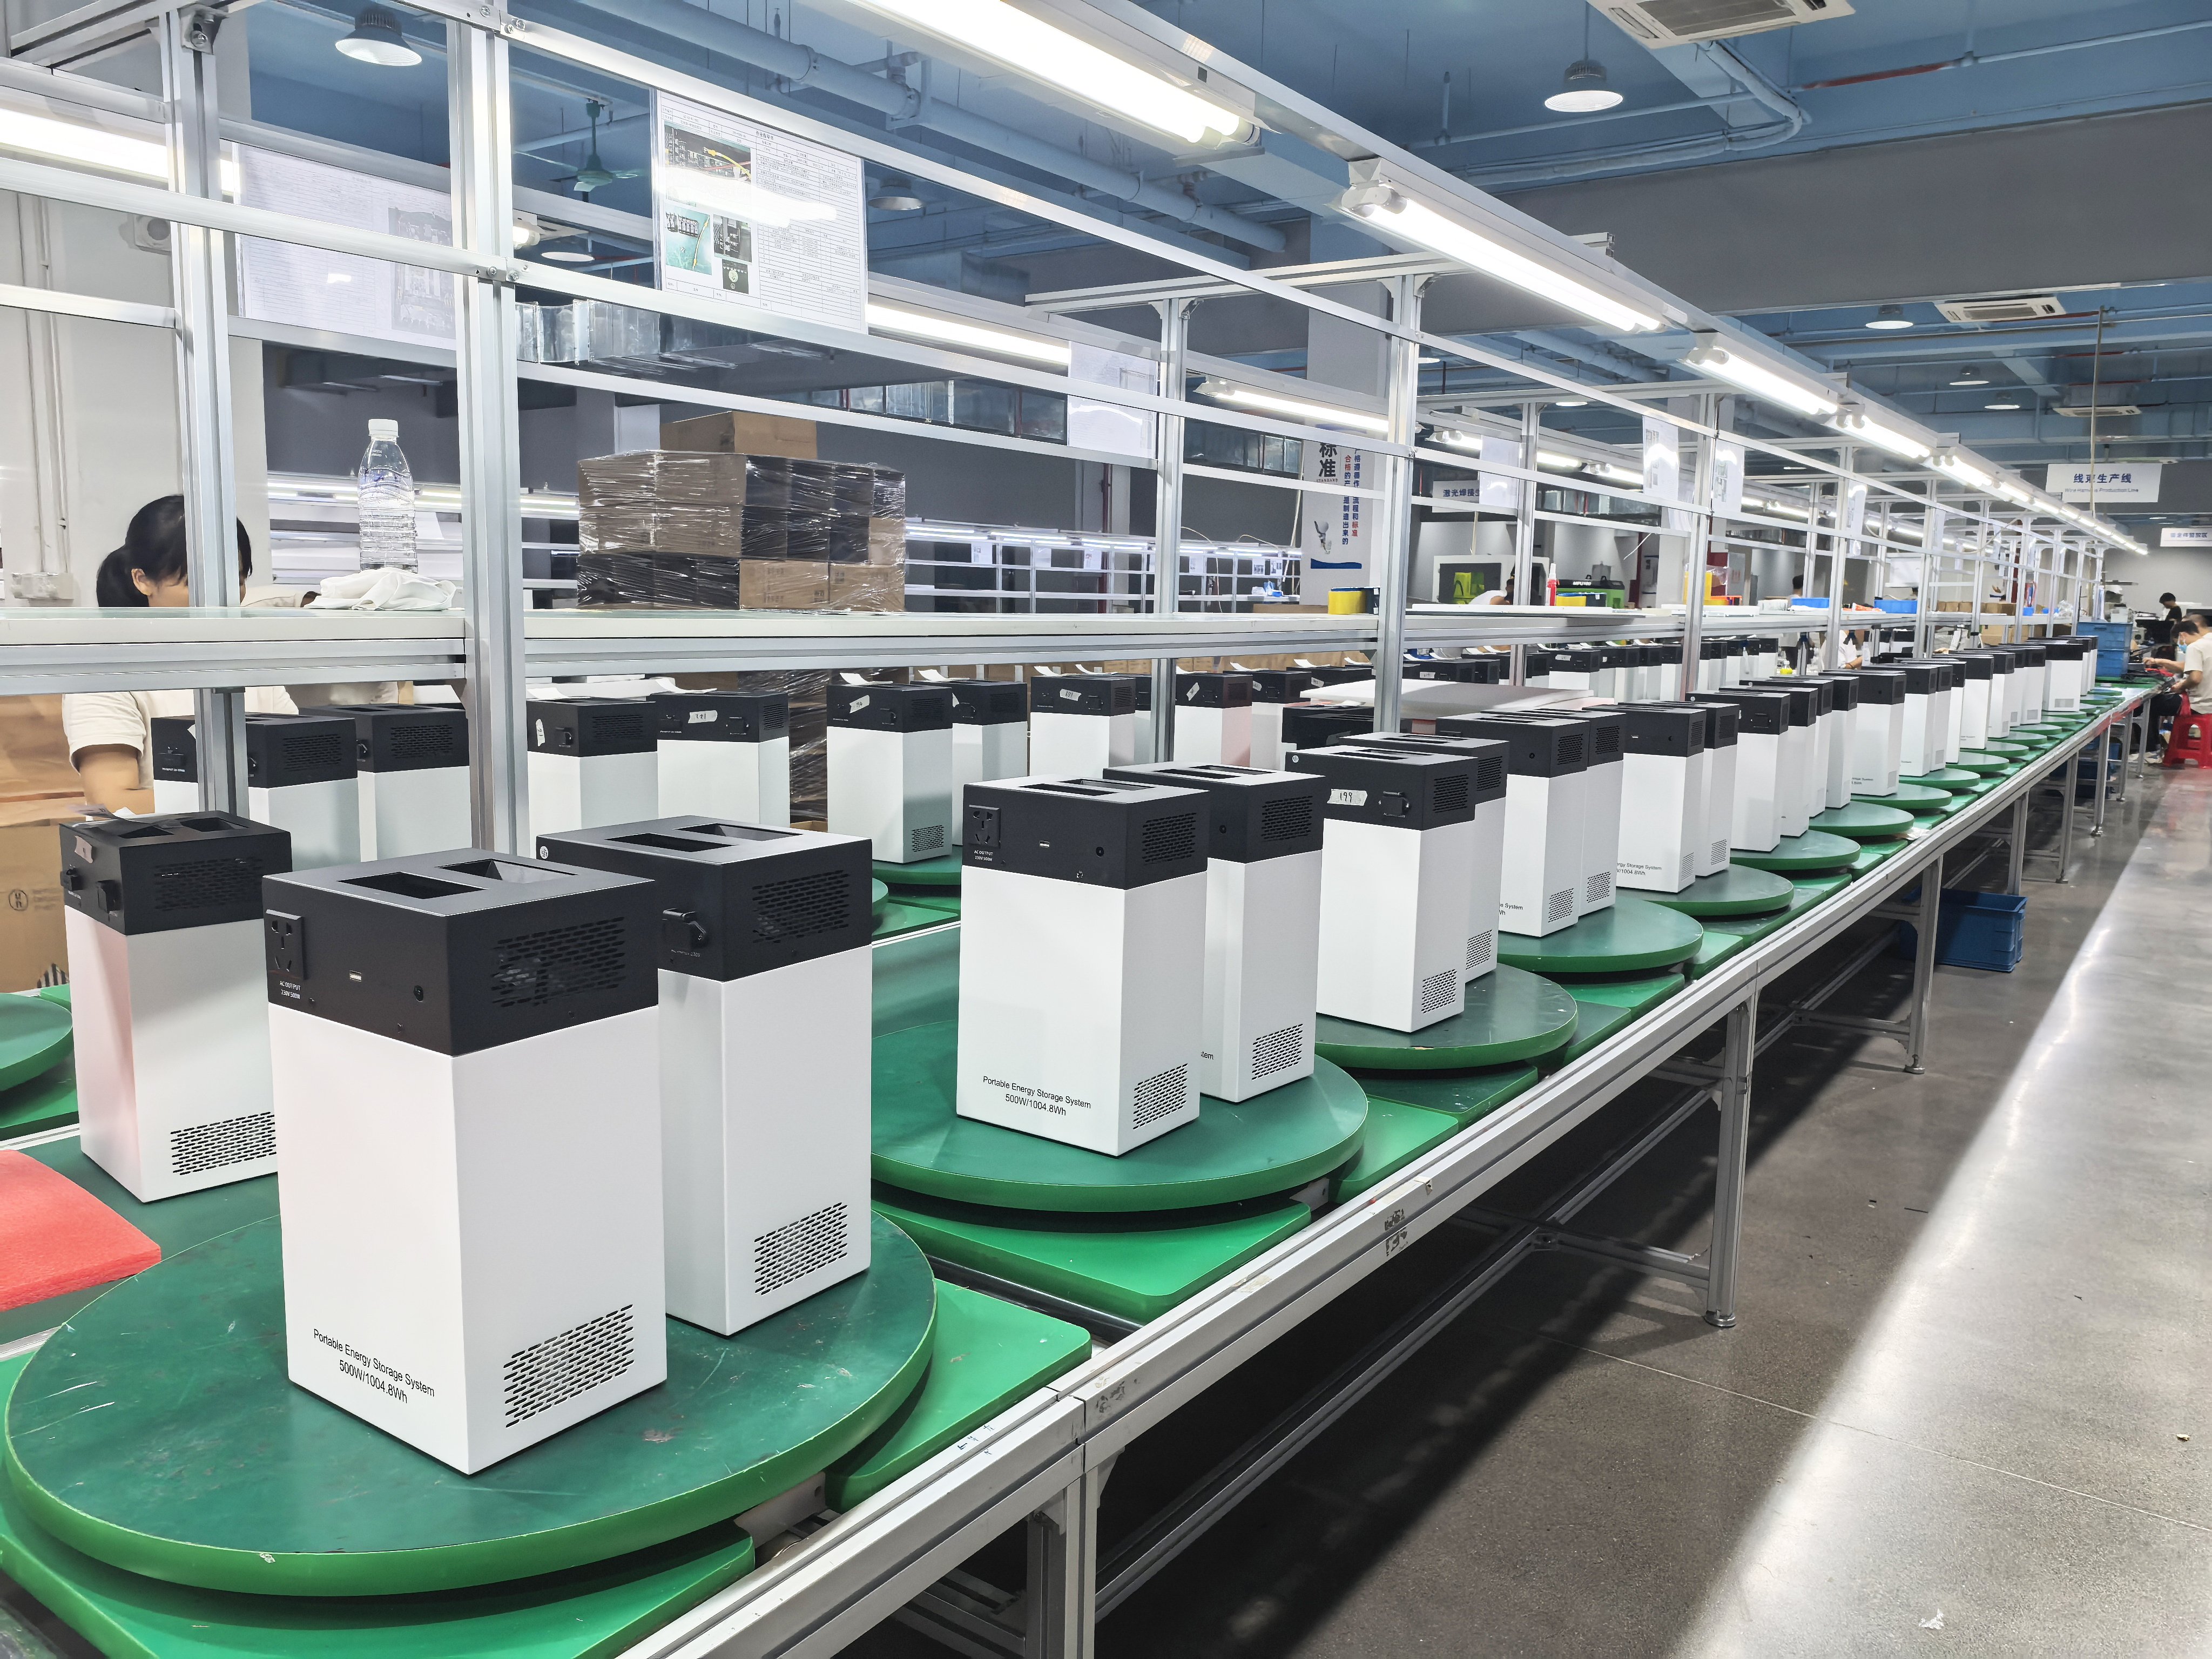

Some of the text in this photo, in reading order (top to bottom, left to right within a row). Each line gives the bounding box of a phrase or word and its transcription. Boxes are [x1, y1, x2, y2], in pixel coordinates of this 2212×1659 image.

[1319, 443, 1337, 477] 标准
[2073, 474, 2132, 483] 线束生产线
[1201, 1051, 1214, 1060] tem
[983, 1076, 1091, 1109] Portable Energy Storage System
[1005, 1094, 1066, 1116] 500W/1004.8Wh
[314, 1328, 434, 1397] Portable Energy Storage System
[340, 1359, 407, 1404] 500W/1004.8Wh
